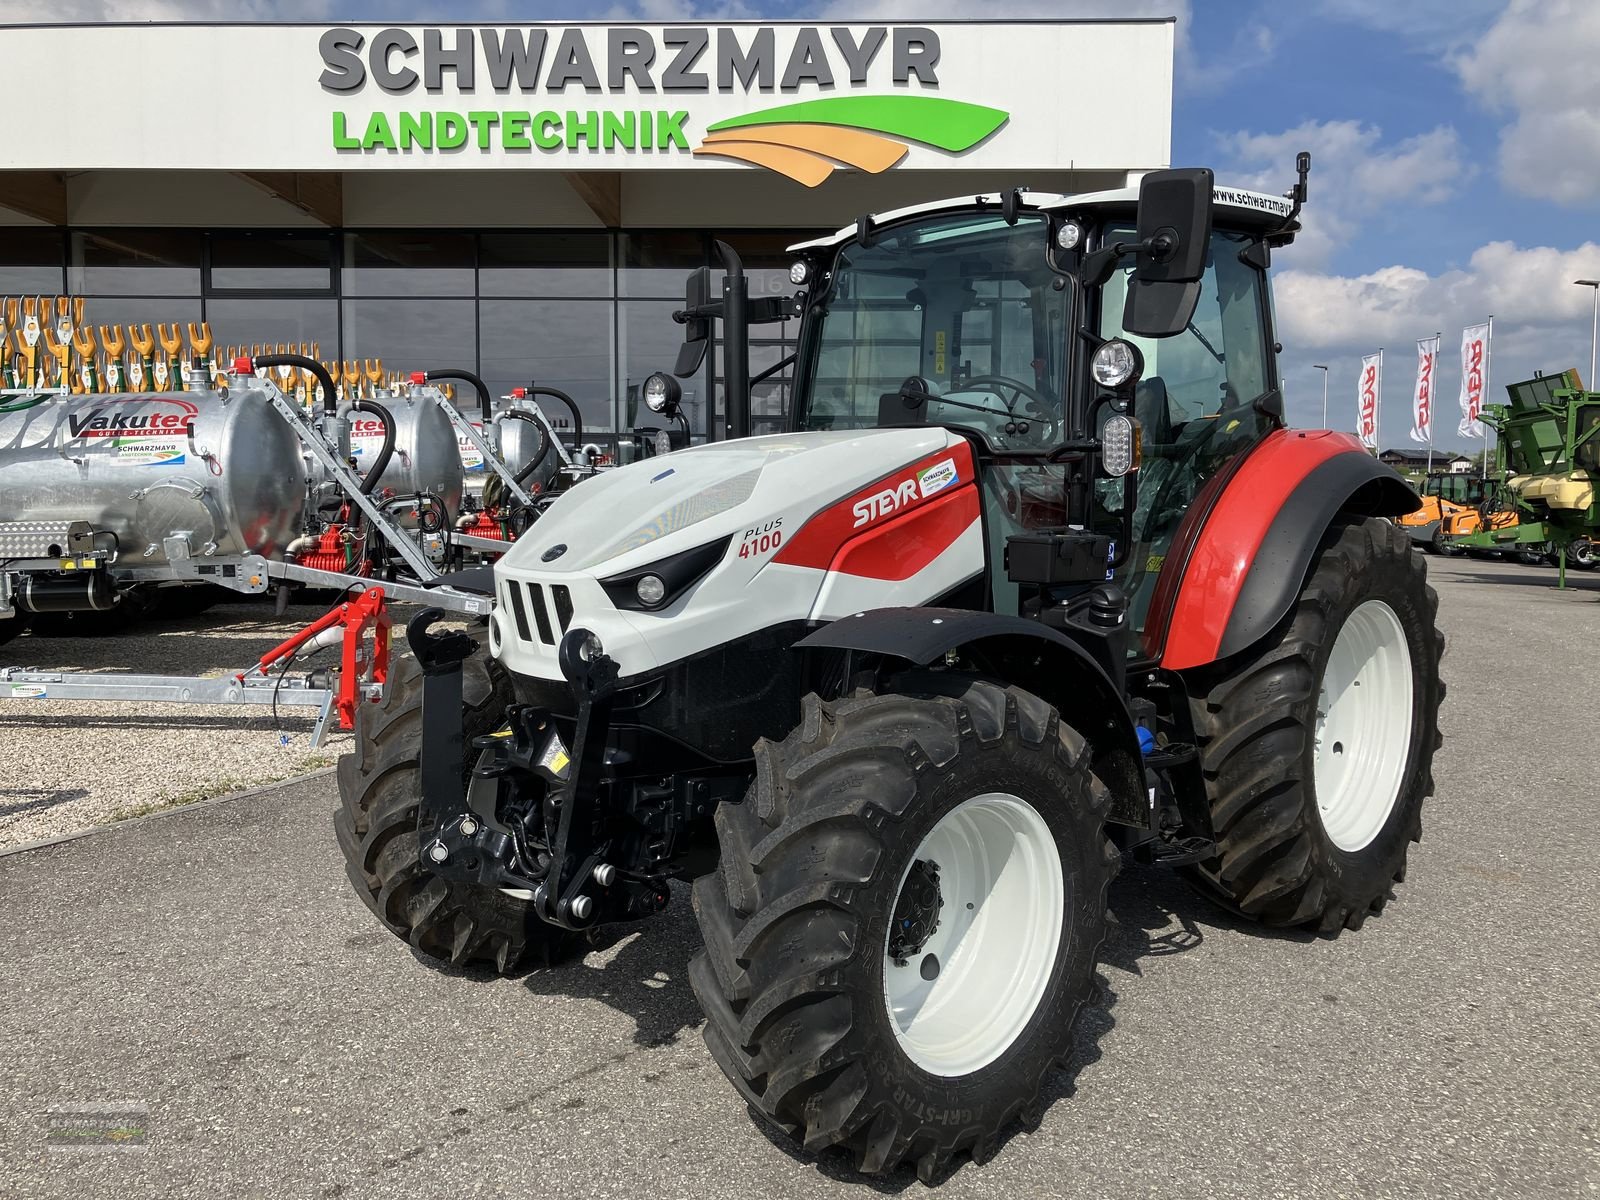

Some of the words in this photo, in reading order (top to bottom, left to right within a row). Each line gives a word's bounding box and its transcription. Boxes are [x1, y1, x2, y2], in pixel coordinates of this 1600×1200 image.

[318, 27, 940, 93] SCHWARZMAYR
[332, 110, 690, 152] LANDTECHNIK
[68, 408, 198, 438] Vakutec
[852, 479, 919, 529] STEYR
[738, 529, 782, 560] 4100
[743, 516, 783, 541] PLUS
